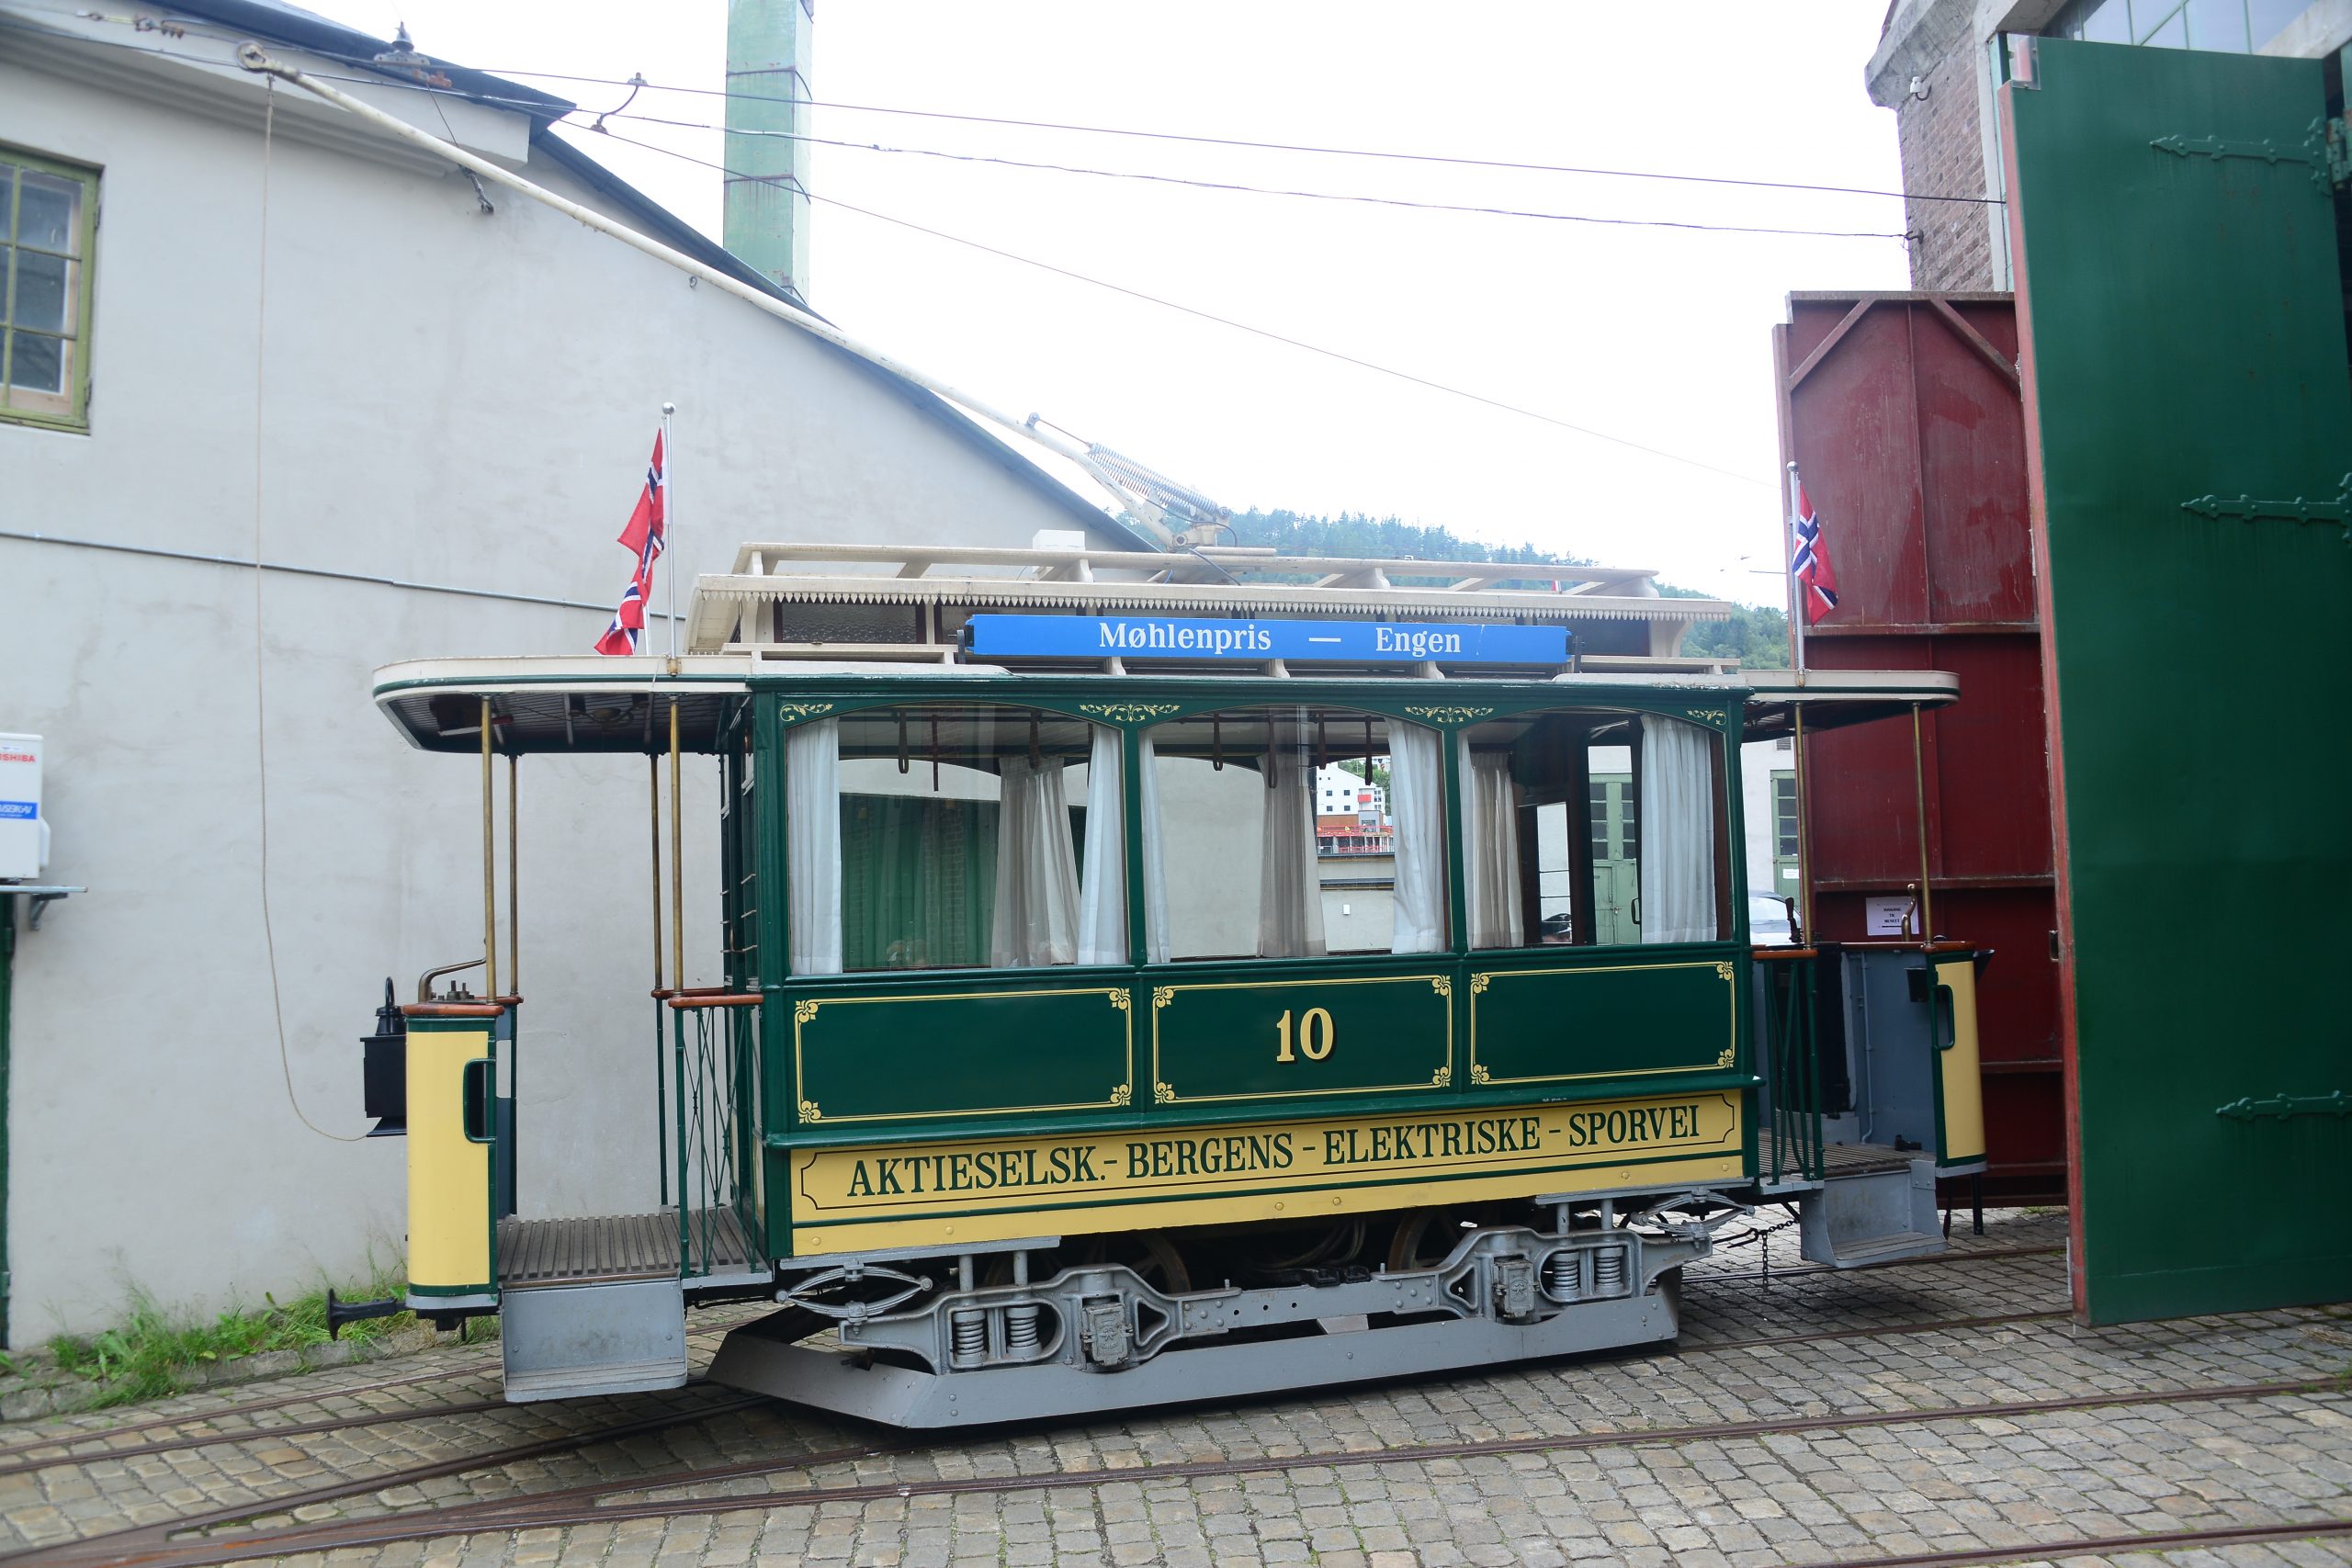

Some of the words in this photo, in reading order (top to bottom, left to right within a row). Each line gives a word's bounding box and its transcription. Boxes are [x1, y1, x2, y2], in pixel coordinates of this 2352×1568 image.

[1099, 622, 1272, 655] Møhlenpris
[1375, 626, 1462, 658] Engen
[0, 753, 36, 762] SHIBA
[1276, 1007, 1335, 1062] 10
[1568, 1104, 1700, 1147] SPORVEI
